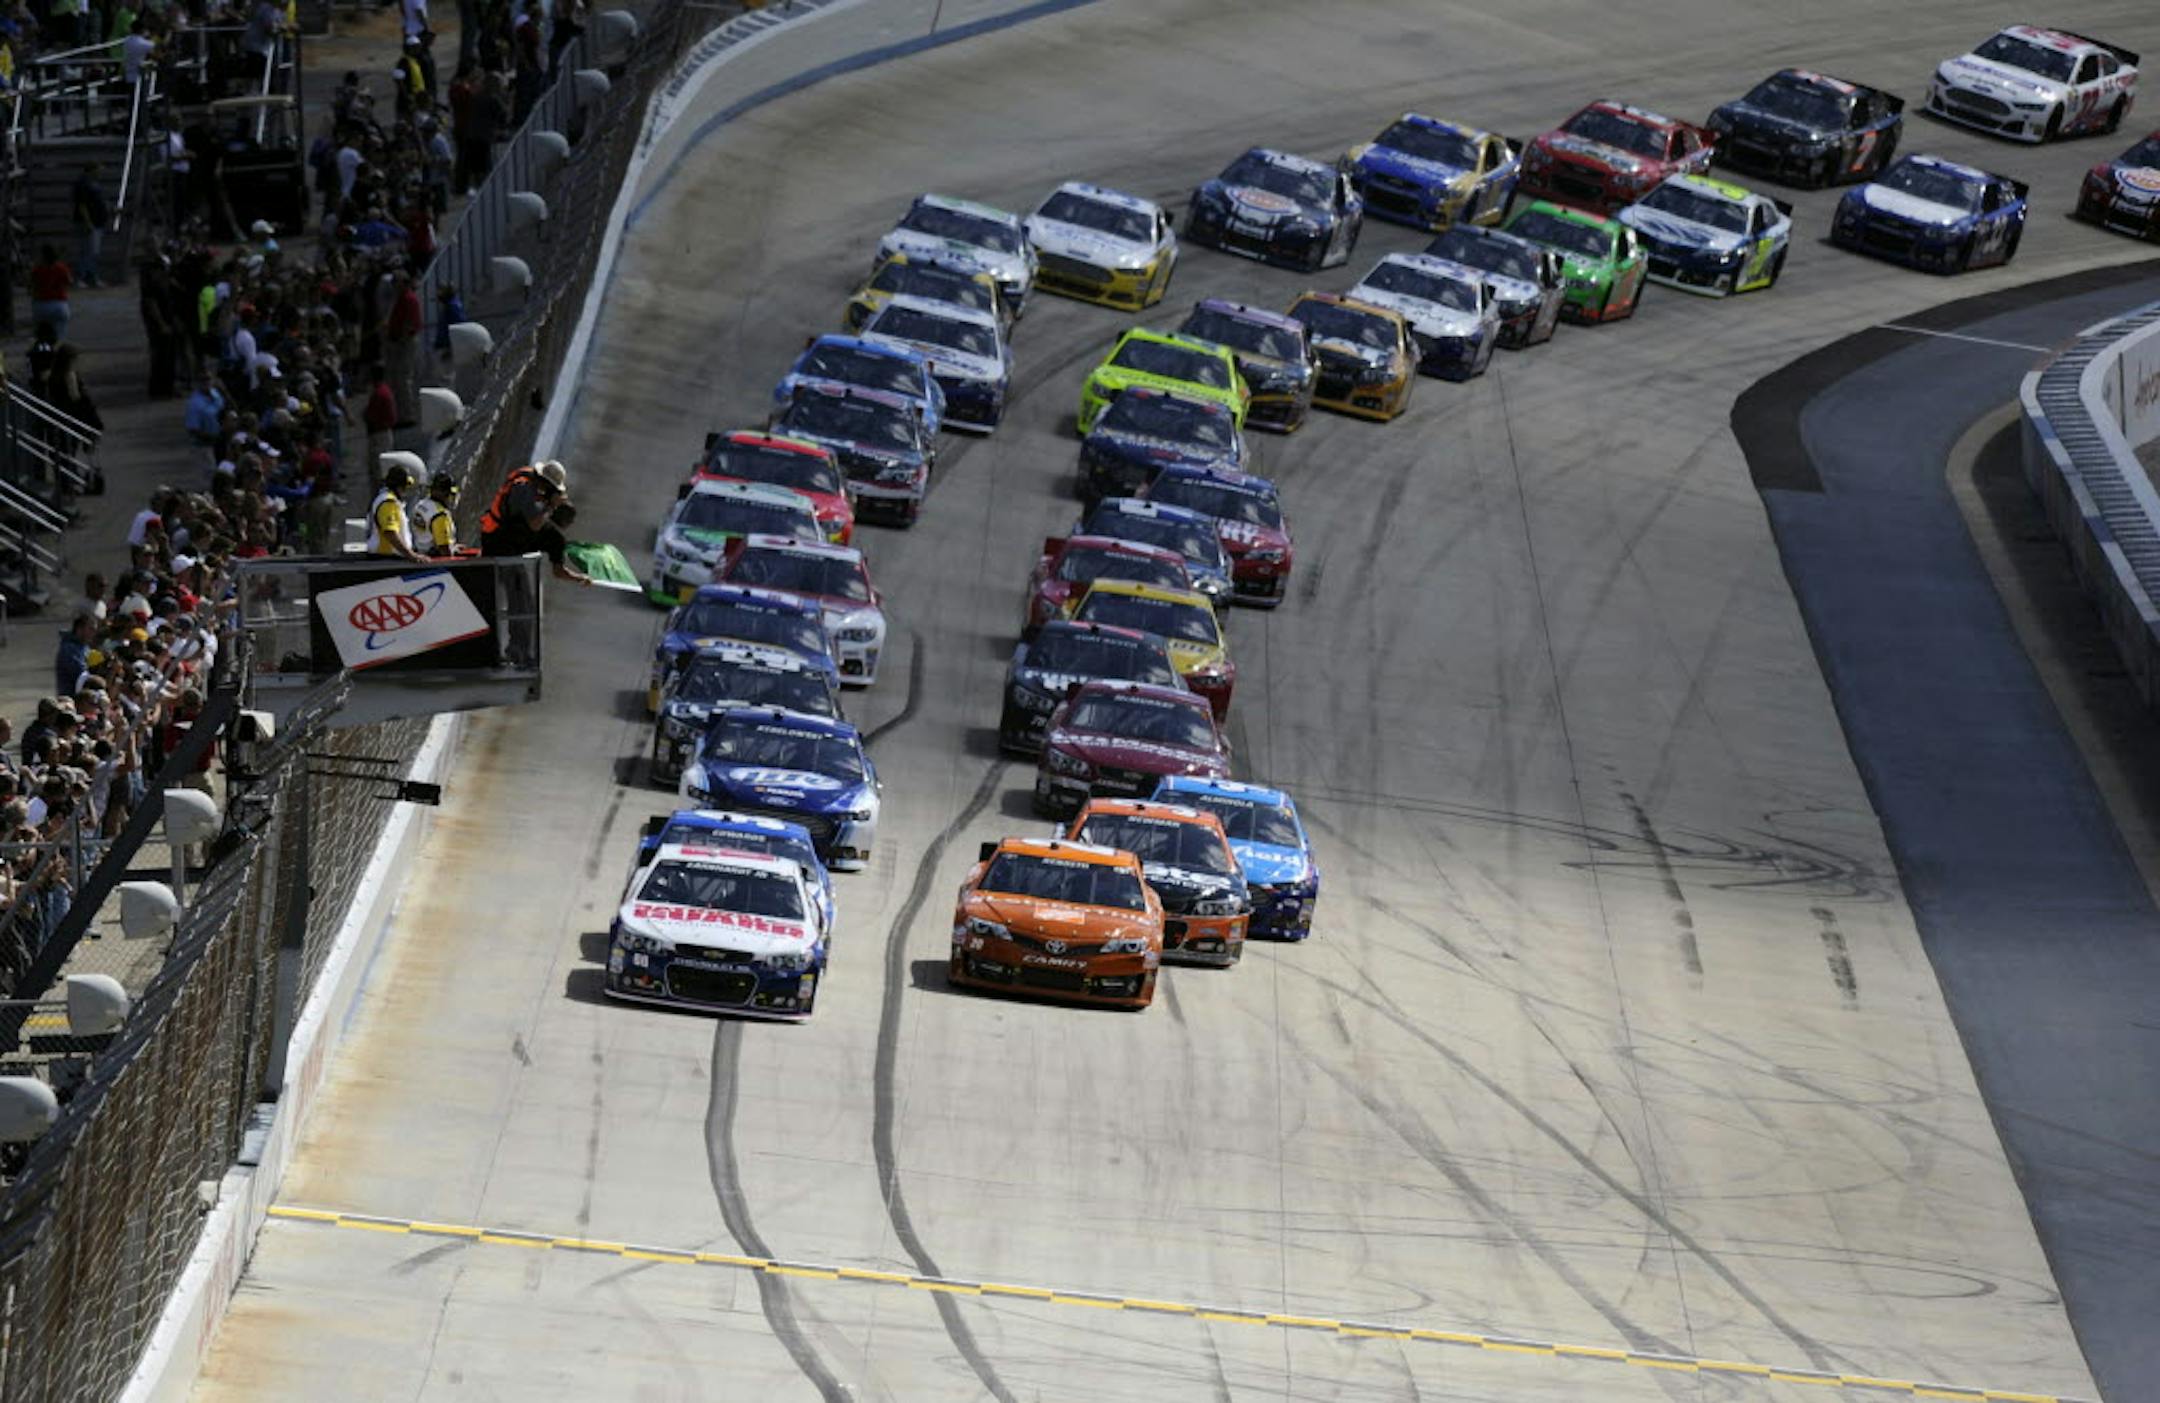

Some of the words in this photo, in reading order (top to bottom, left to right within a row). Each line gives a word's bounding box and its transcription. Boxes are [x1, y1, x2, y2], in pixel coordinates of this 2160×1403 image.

[353, 597, 419, 631] AAA
[711, 830, 766, 841] EDWARDS
[686, 860, 751, 877] EARNHARDT
[1022, 954, 1088, 969] CAMRY
